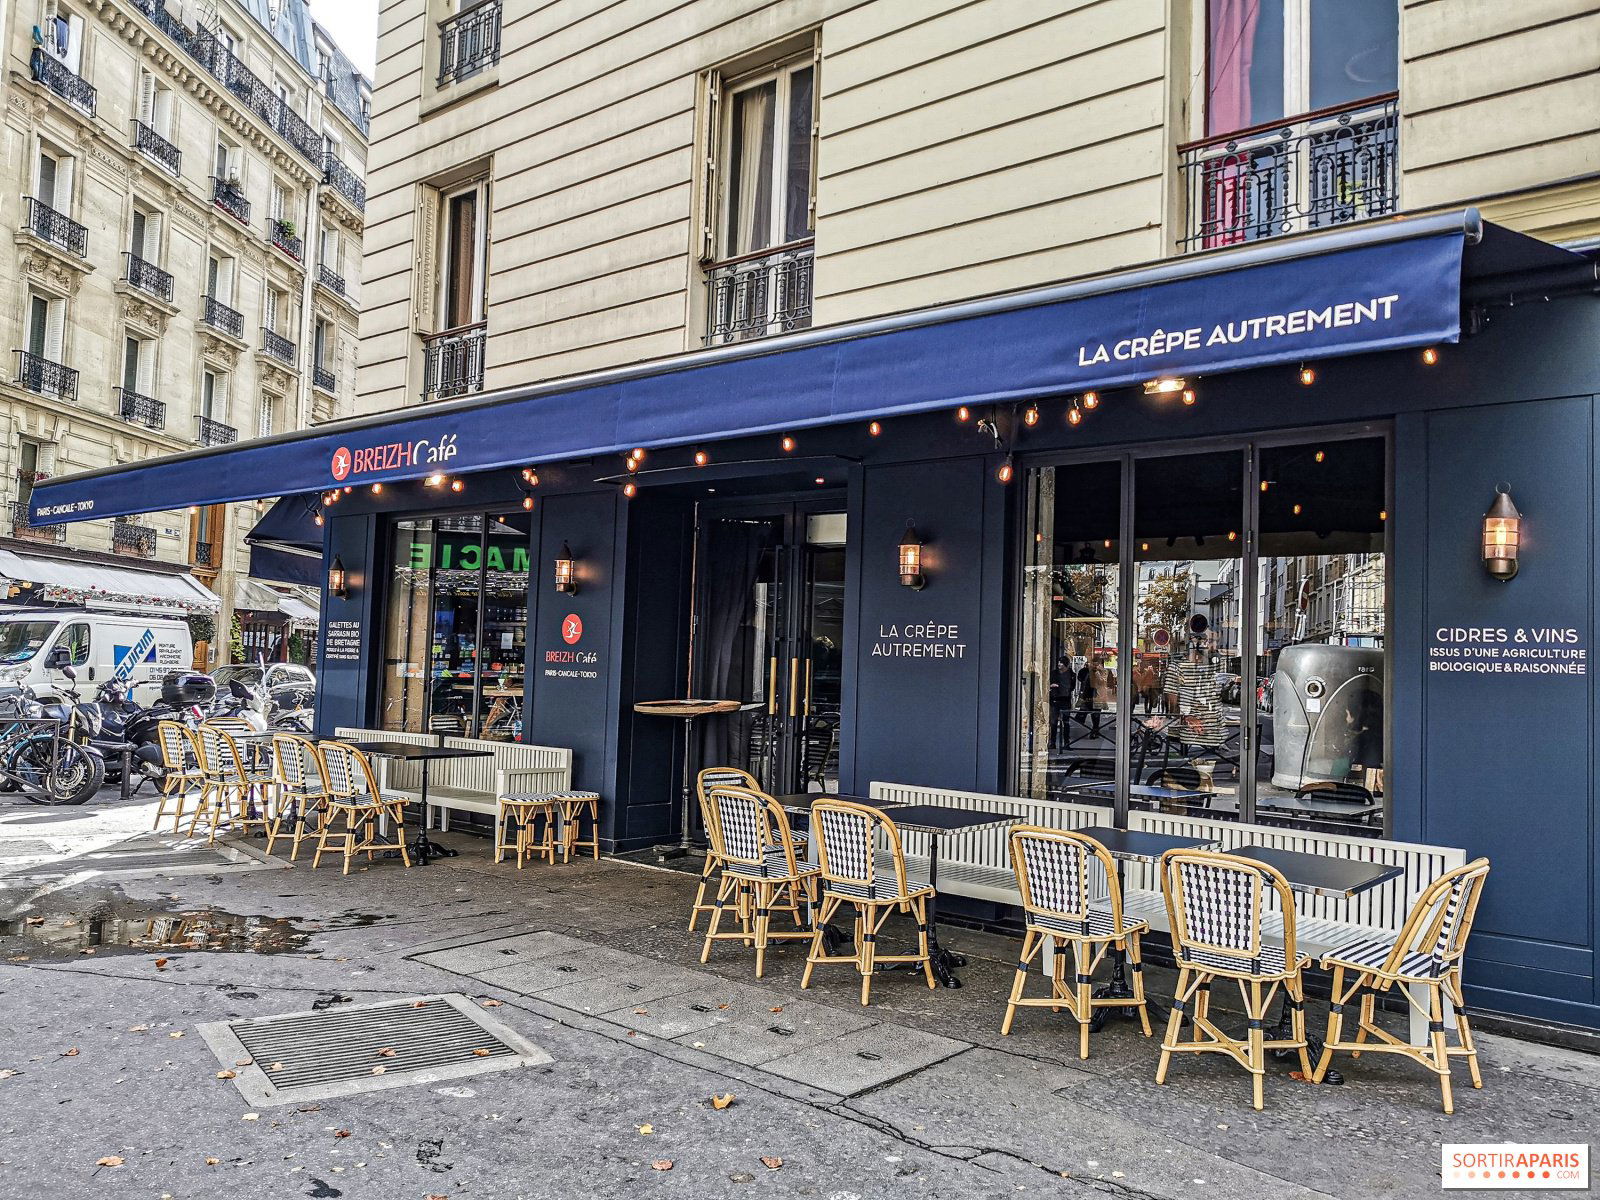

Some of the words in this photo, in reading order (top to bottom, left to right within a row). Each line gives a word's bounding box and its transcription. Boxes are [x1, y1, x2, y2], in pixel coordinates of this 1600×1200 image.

[1078, 344, 1110, 366] LA
[1113, 328, 1201, 360] CRÊPE
[1206, 294, 1399, 347] AUTREMENT
[353, 441, 411, 473] BREIZH
[412, 433, 457, 465] Café
[880, 624, 899, 638] LA
[904, 620, 958, 639] CRÊPE
[1436, 627, 1508, 643] CIDRES
[1514, 628, 1529, 643] &
[1531, 628, 1579, 644] VINS
[545, 650, 575, 663] BREIZH
[575, 651, 597, 664] Café
[871, 643, 966, 658] AUTREMENT
[1430, 647, 1460, 657] ISSUS
[1463, 648, 1499, 658] D'UNE
[1502, 648, 1587, 659] AGRICULTURE
[1430, 662, 1502, 673] BIOLOGIQUE
[1513, 661, 1586, 675] RAISONNÉE
